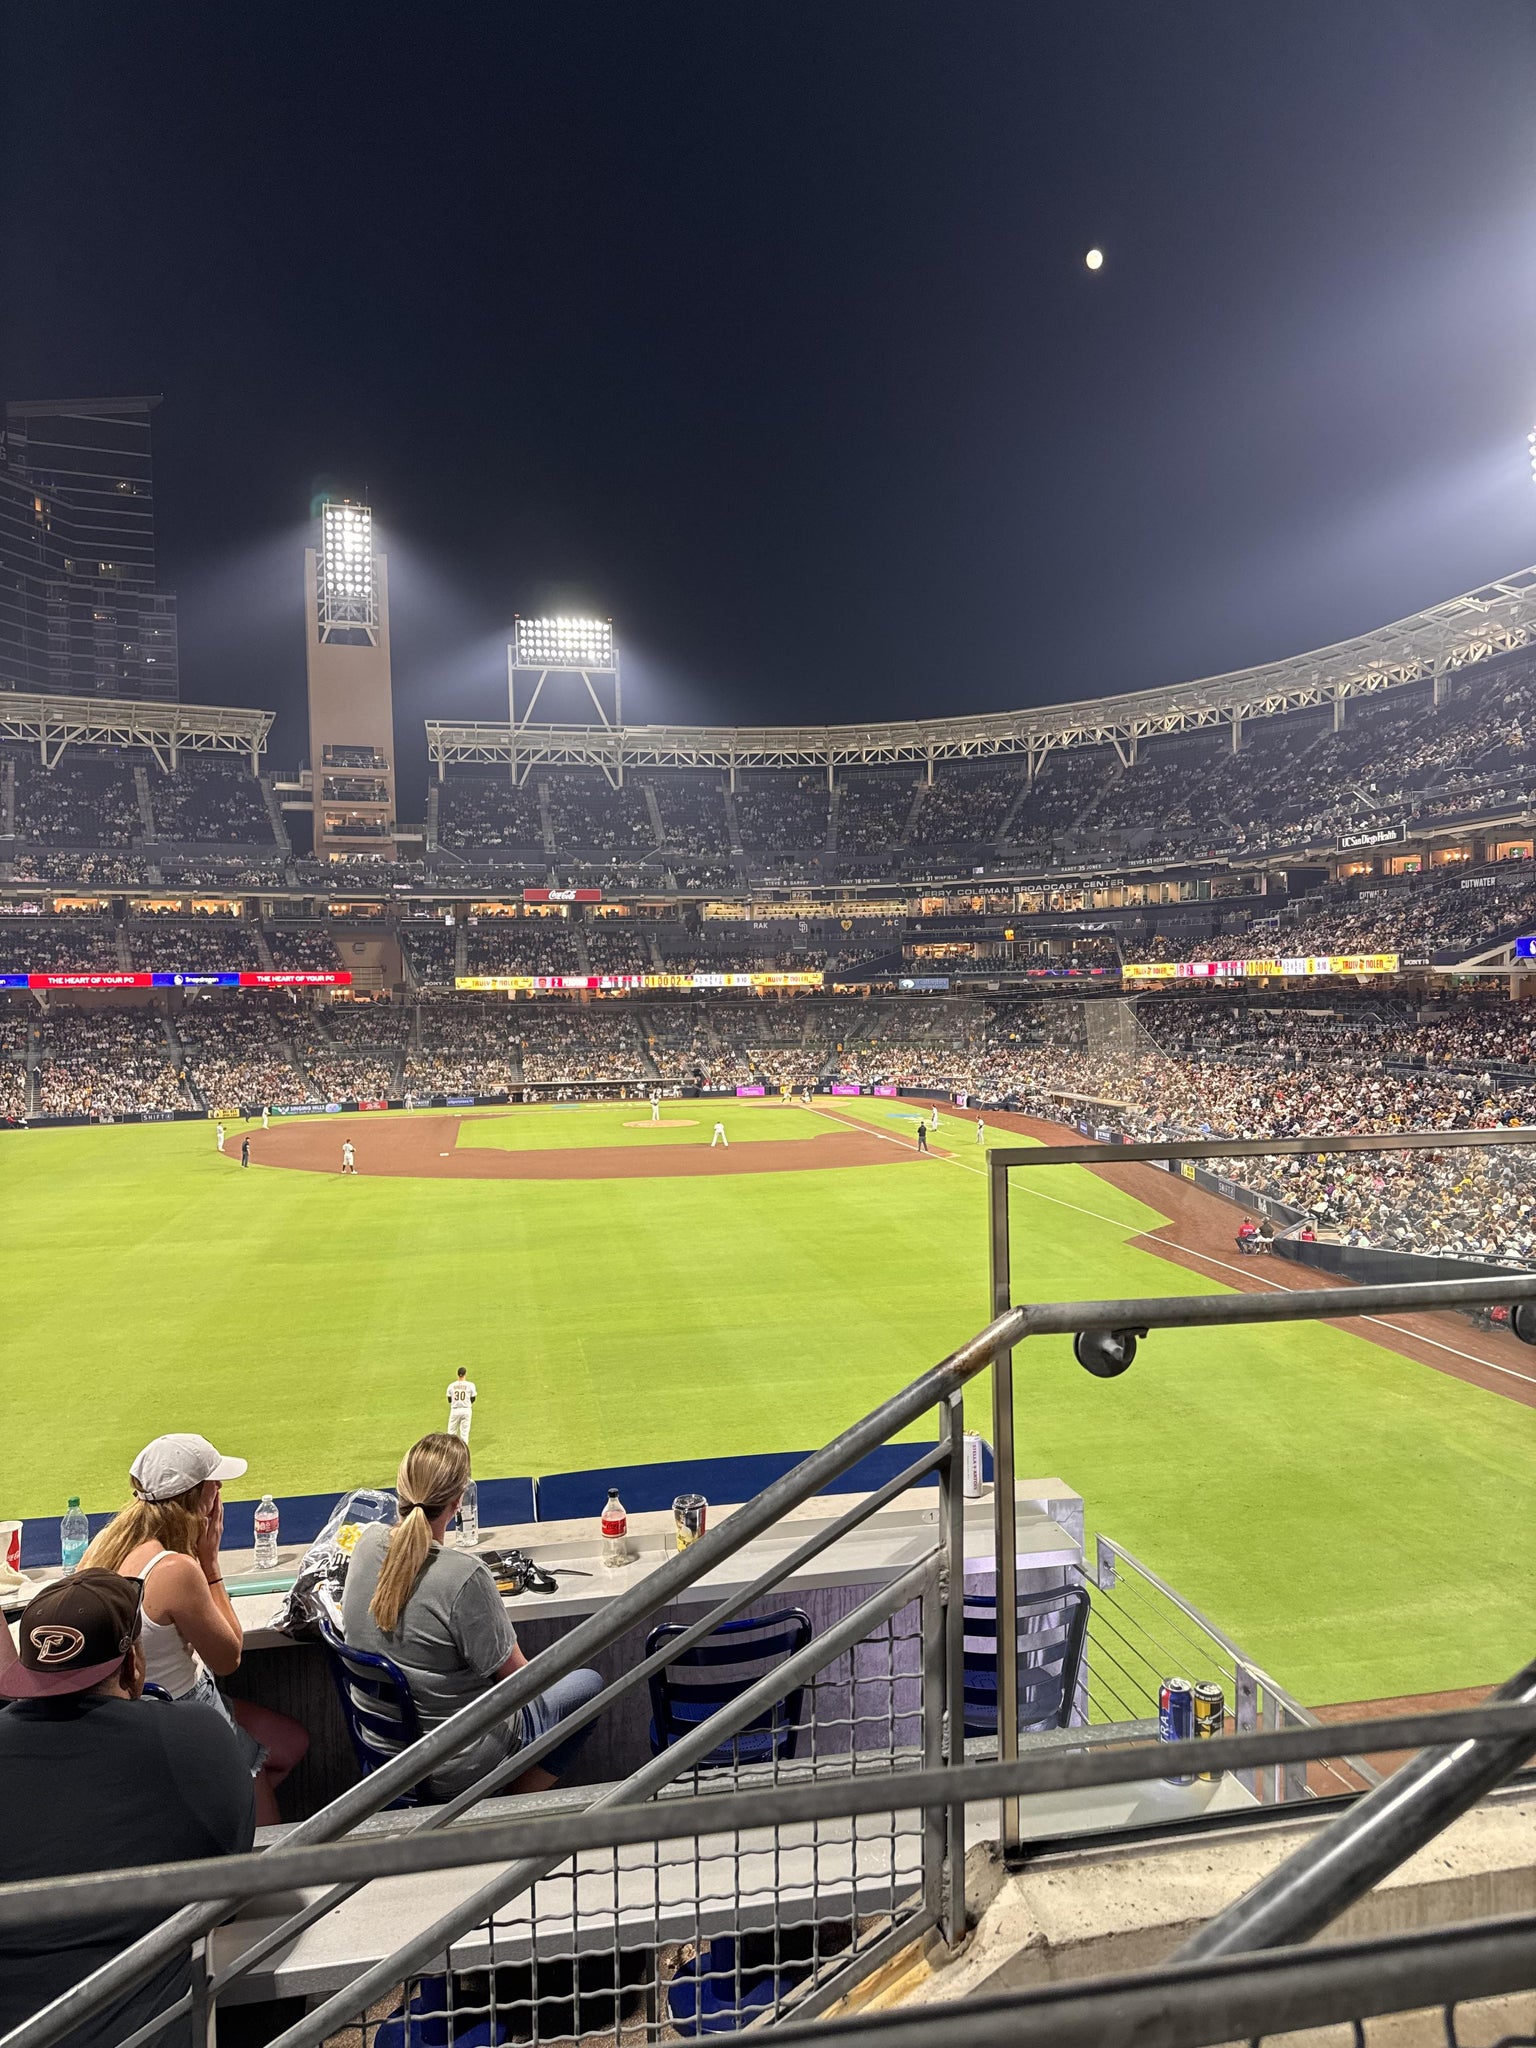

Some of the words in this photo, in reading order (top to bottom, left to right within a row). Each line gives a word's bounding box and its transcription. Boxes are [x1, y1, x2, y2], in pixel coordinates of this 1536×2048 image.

[1341, 838, 1350, 848] UC
[1350, 836, 1362, 846] San
[1362, 833, 1377, 845] Diego
[1377, 830, 1397, 842] Health
[1153, 856, 1175, 864] HOFFMAN
[919, 889, 953, 898] JERRY
[957, 886, 1009, 897] COLEMAN
[1013, 882, 1079, 894] BROADCAST
[1083, 878, 1125, 889] CENTER
[1460, 877, 1496, 889] CUTWATER
[1365, 960, 1384, 968] NOLEN
[185, 976, 219, 984] Snapdragon
[454, 1390, 466, 1401] 30
